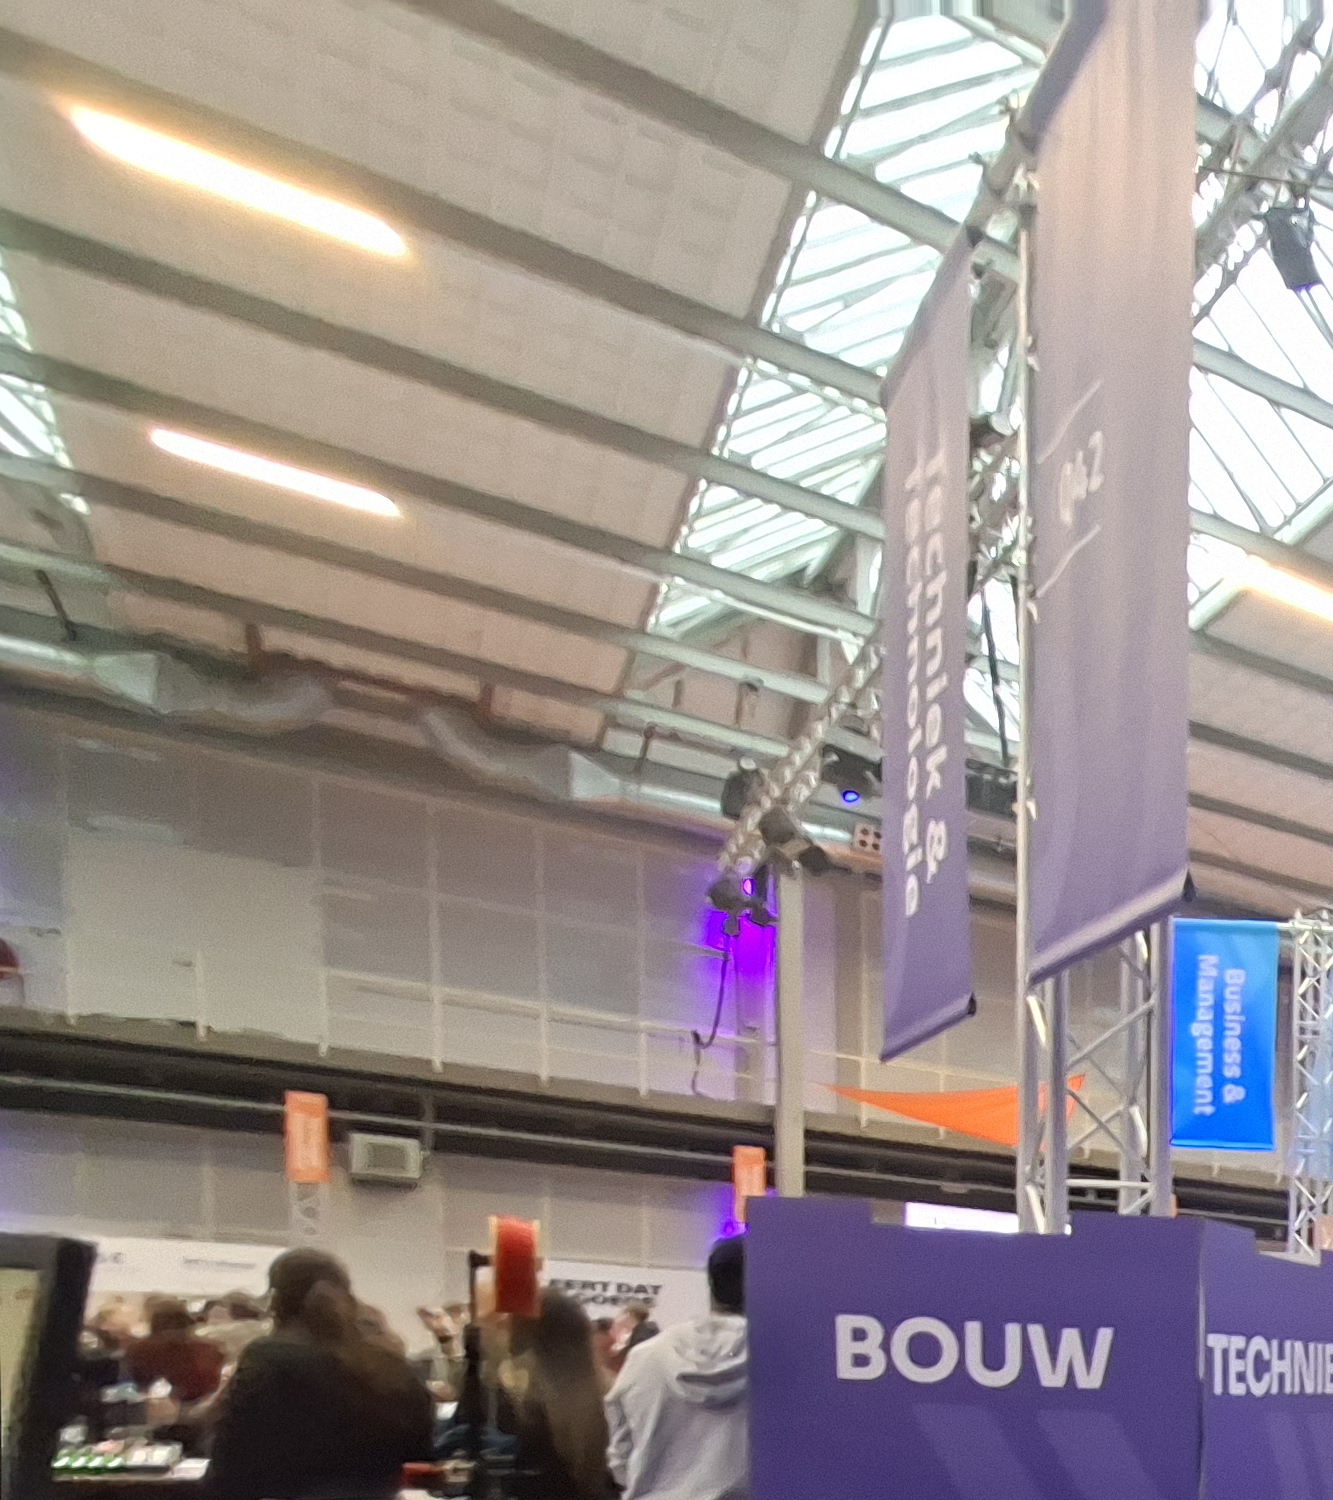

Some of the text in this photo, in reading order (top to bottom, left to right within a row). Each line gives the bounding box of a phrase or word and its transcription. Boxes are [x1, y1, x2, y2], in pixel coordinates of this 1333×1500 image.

[924, 819, 948, 884] &
[1190, 954, 1219, 1117] Management
[1222, 968, 1247, 1105] Business &
[834, 1313, 1115, 1390] BOUW
